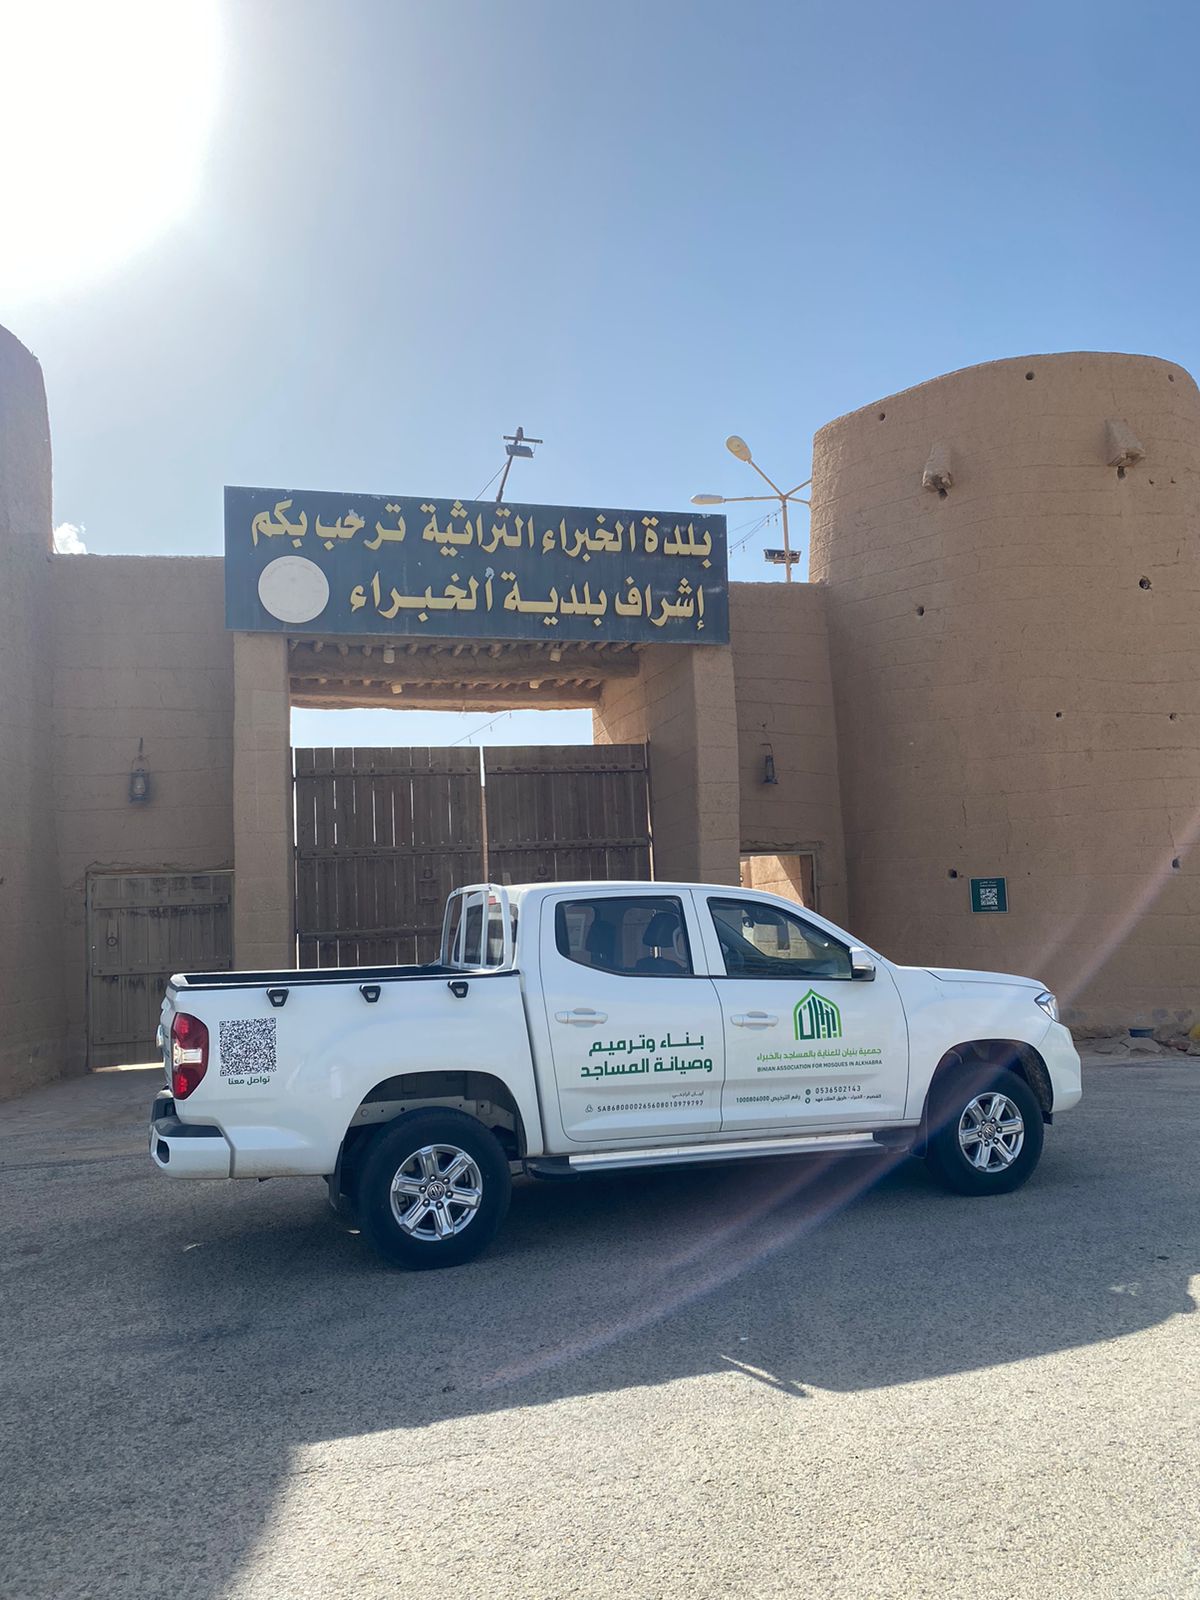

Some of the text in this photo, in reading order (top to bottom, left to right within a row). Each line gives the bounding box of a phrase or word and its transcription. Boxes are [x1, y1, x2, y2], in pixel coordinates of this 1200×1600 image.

[251, 499, 712, 568] بلدة الخبراء التراثية ترحب بكم
[350, 571, 705, 630] إشراف بلدية الخبراء
[589, 1032, 704, 1056] بناء وترميم
[756, 1048, 882, 1062] جمعية بنيان للعناية بالمساجد بالخبراء
[580, 1056, 713, 1080] وصيانة المساجد
[247, 1076, 270, 1086] تواصل
[815, 1085, 861, 1095] 0536502143
